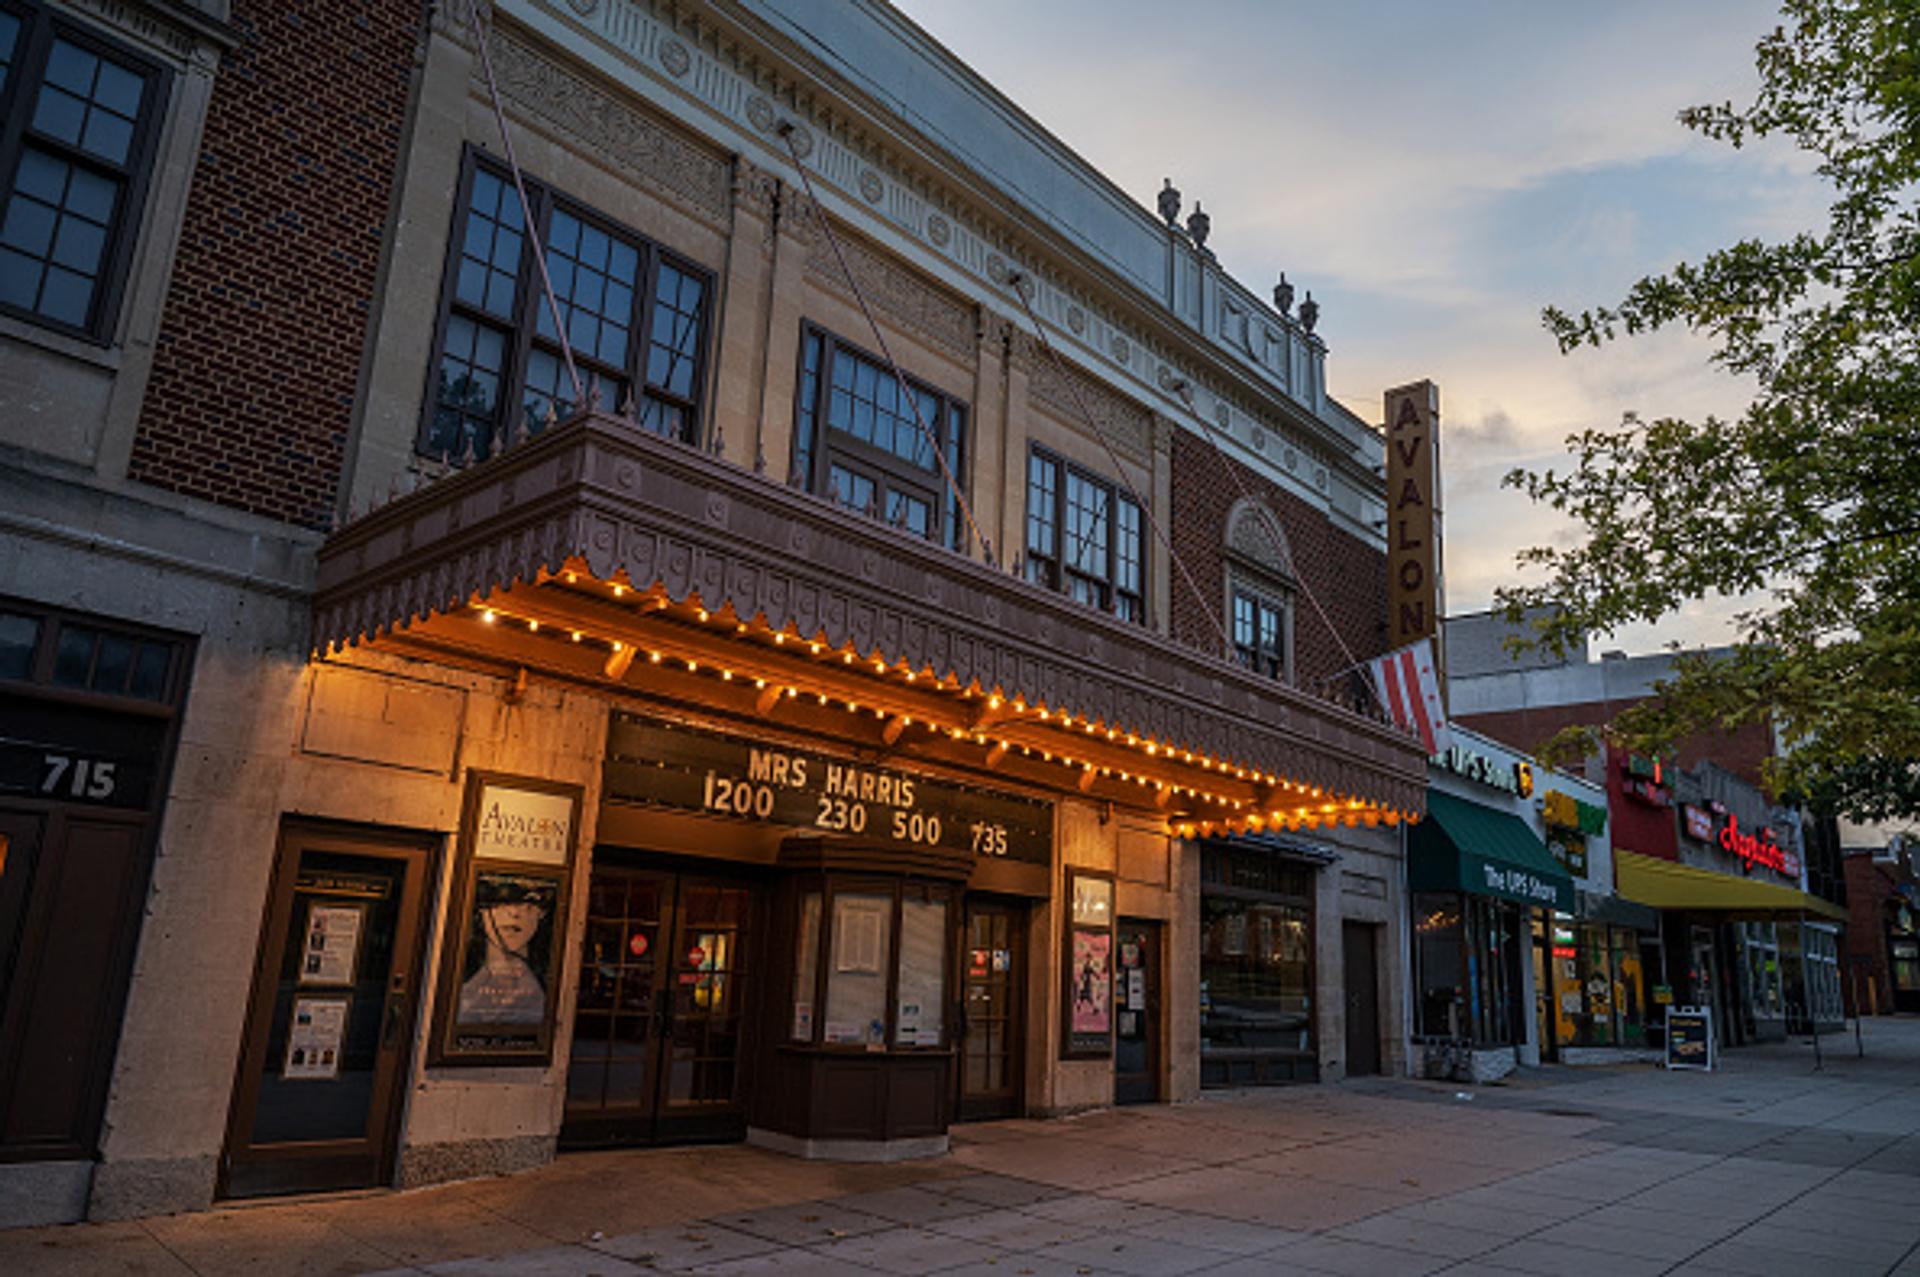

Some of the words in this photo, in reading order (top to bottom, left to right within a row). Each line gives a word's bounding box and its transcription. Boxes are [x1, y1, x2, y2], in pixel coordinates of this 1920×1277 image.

[1394, 397, 1424, 636] AVALON
[42, 754, 115, 799] 715
[749, 748, 808, 788] MRS
[826, 763, 914, 808] HARRIS
[703, 772, 774, 818] 1200
[815, 797, 867, 833] 230
[892, 810, 942, 846] 500
[970, 823, 1008, 855] 735
